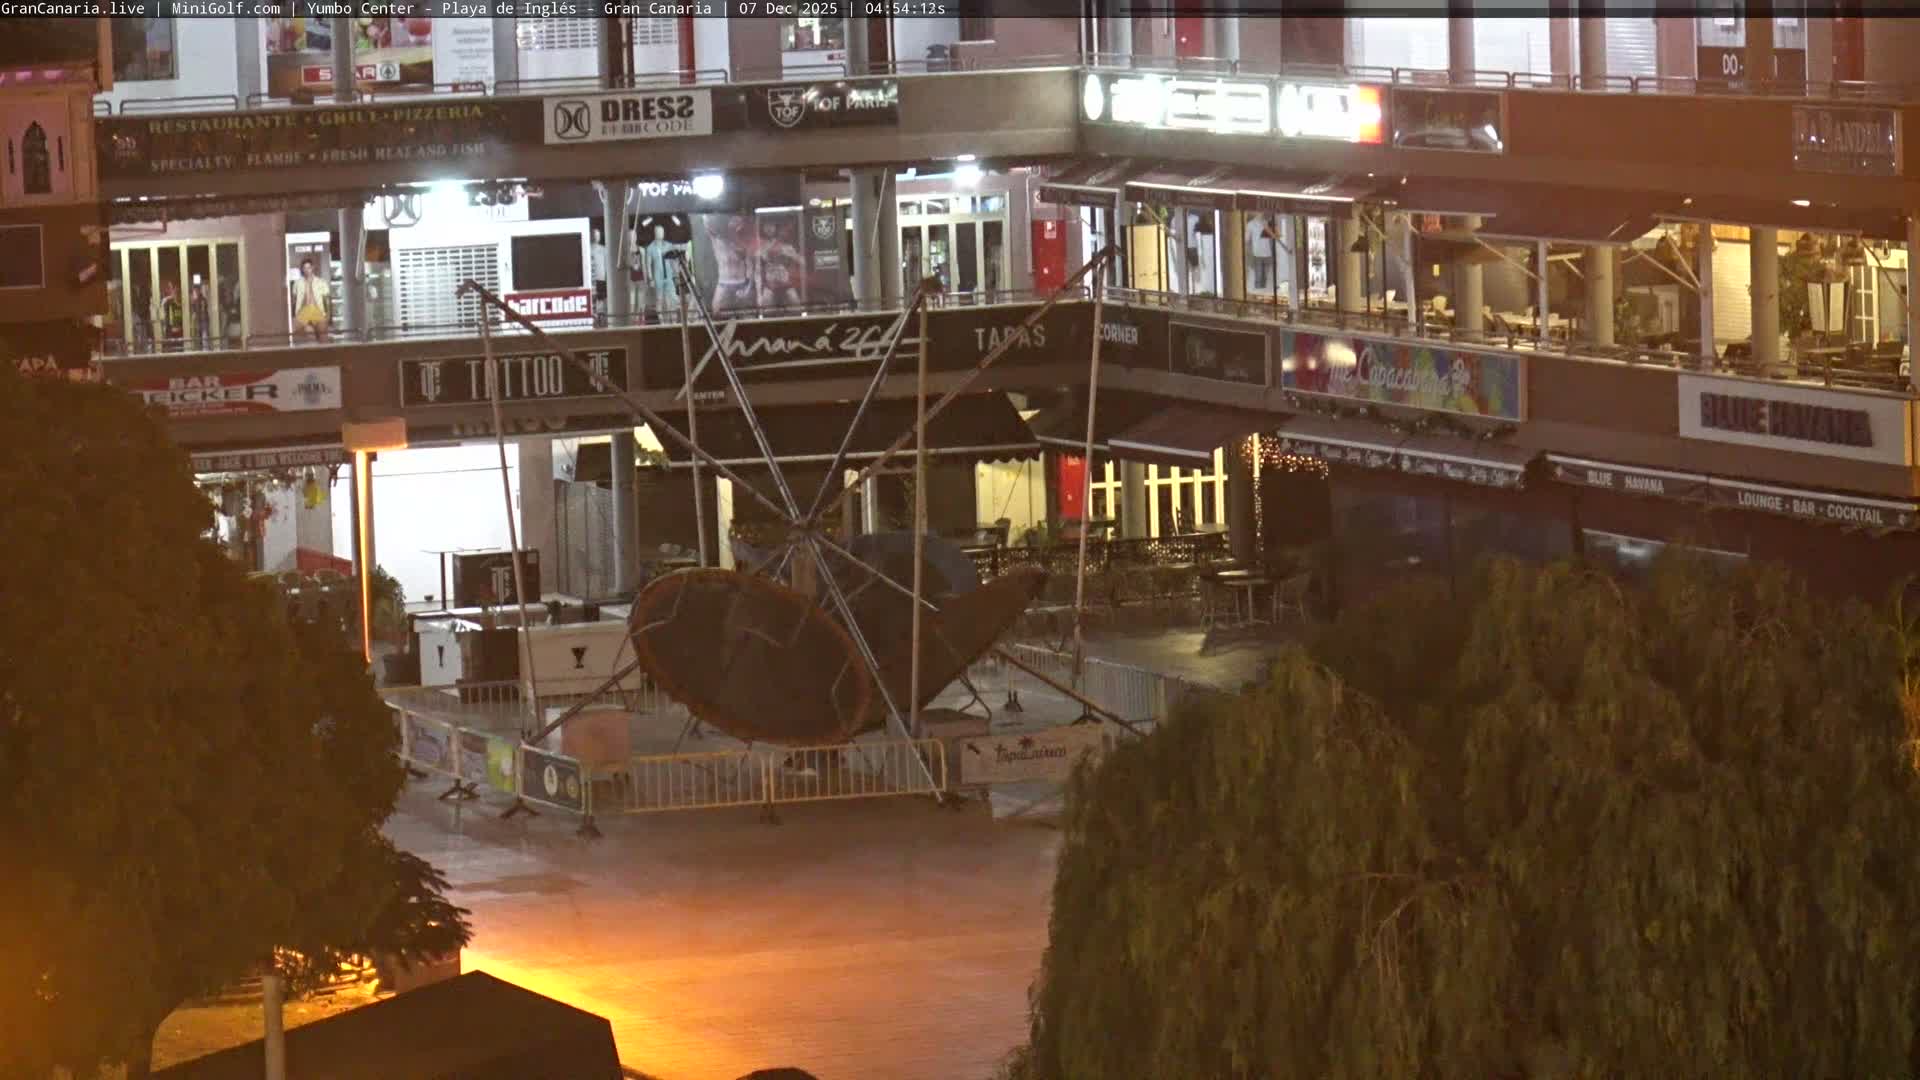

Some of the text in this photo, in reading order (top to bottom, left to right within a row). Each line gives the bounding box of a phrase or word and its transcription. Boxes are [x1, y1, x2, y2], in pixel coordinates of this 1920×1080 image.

[318, 66, 377, 81] SAR
[150, 114, 297, 134] RESTAURANTE
[393, 104, 483, 121] PIZZERIA
[775, 106, 799, 118] TOF
[419, 143, 447, 159] AND
[975, 323, 1046, 351] TAPAS
[1097, 321, 1139, 345] CORNER
[169, 376, 220, 388] BAR
[465, 355, 563, 400] TATTOO
[1587, 470, 1664, 494] BLUE HAVANA
[1738, 490, 1884, 525] LOUNGE BAR COCKTAIL
